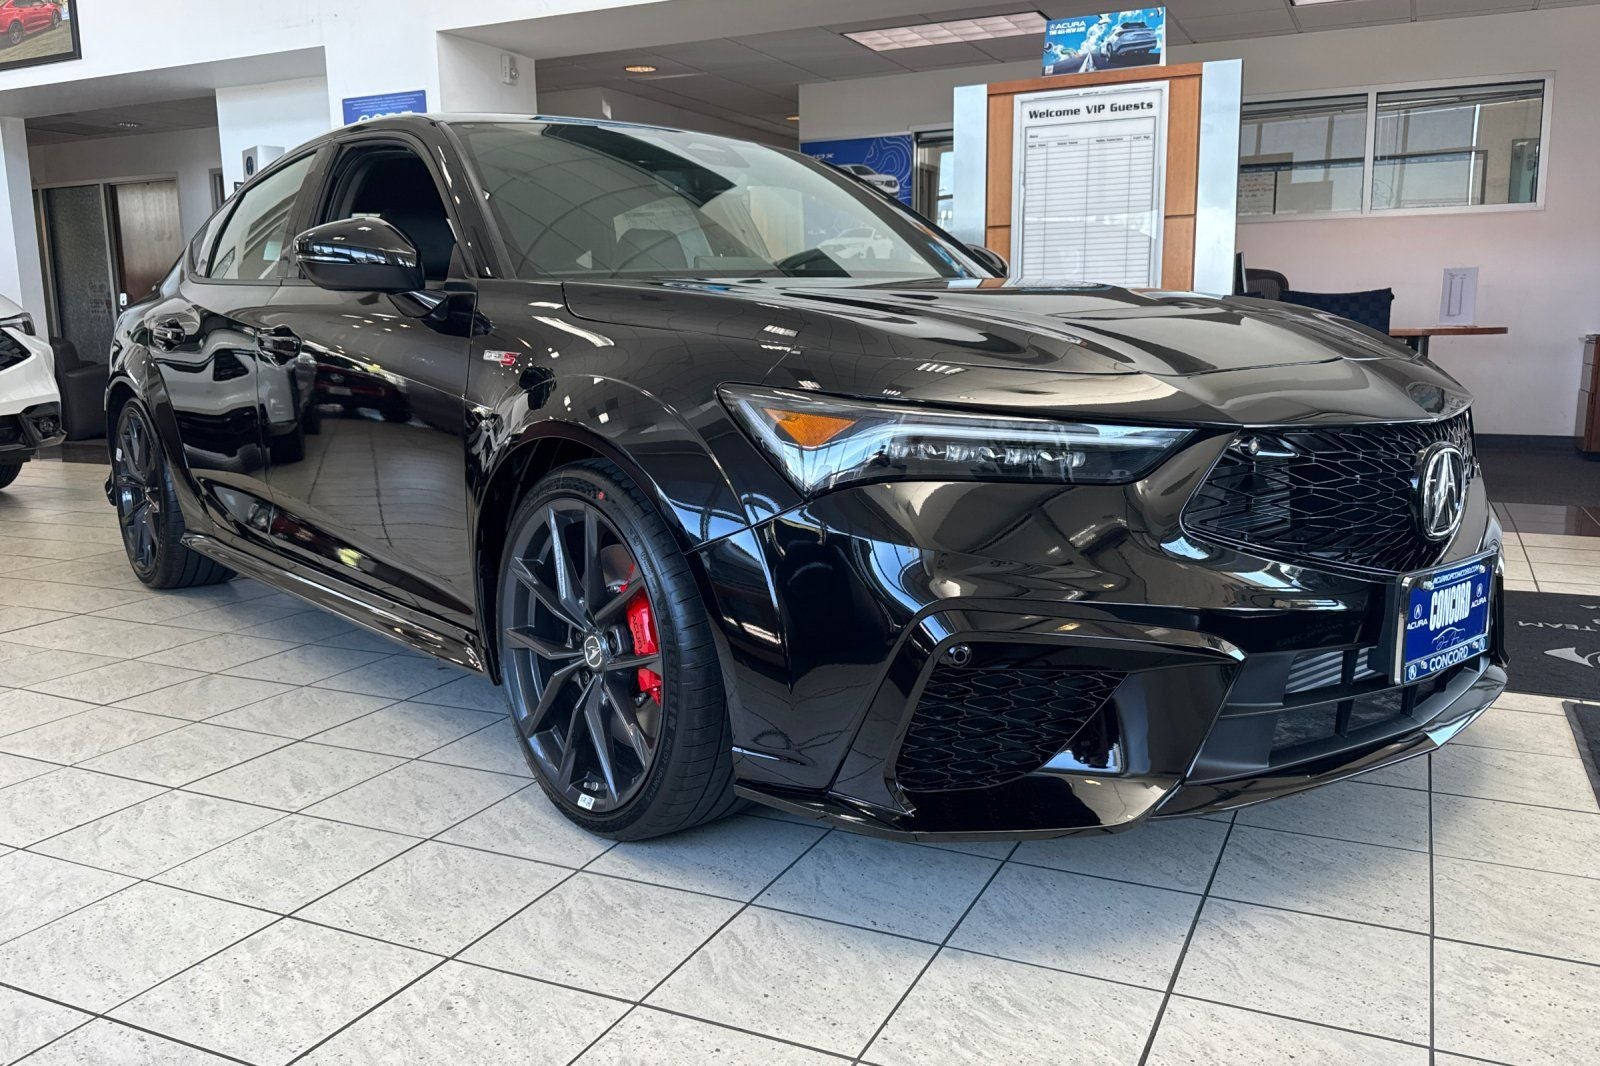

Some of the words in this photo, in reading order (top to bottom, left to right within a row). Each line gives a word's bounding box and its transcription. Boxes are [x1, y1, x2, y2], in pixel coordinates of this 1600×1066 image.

[1028, 107, 1080, 119] Welcome
[1086, 104, 1105, 114] VIP
[1110, 101, 1154, 112] Guests
[1430, 581, 1472, 631] CONCORD
[1471, 597, 1486, 608] ACURA
[1407, 618, 1428, 630] ACURA
[1518, 620, 1598, 632] TEAM
[1429, 646, 1468, 672] CONCORD
